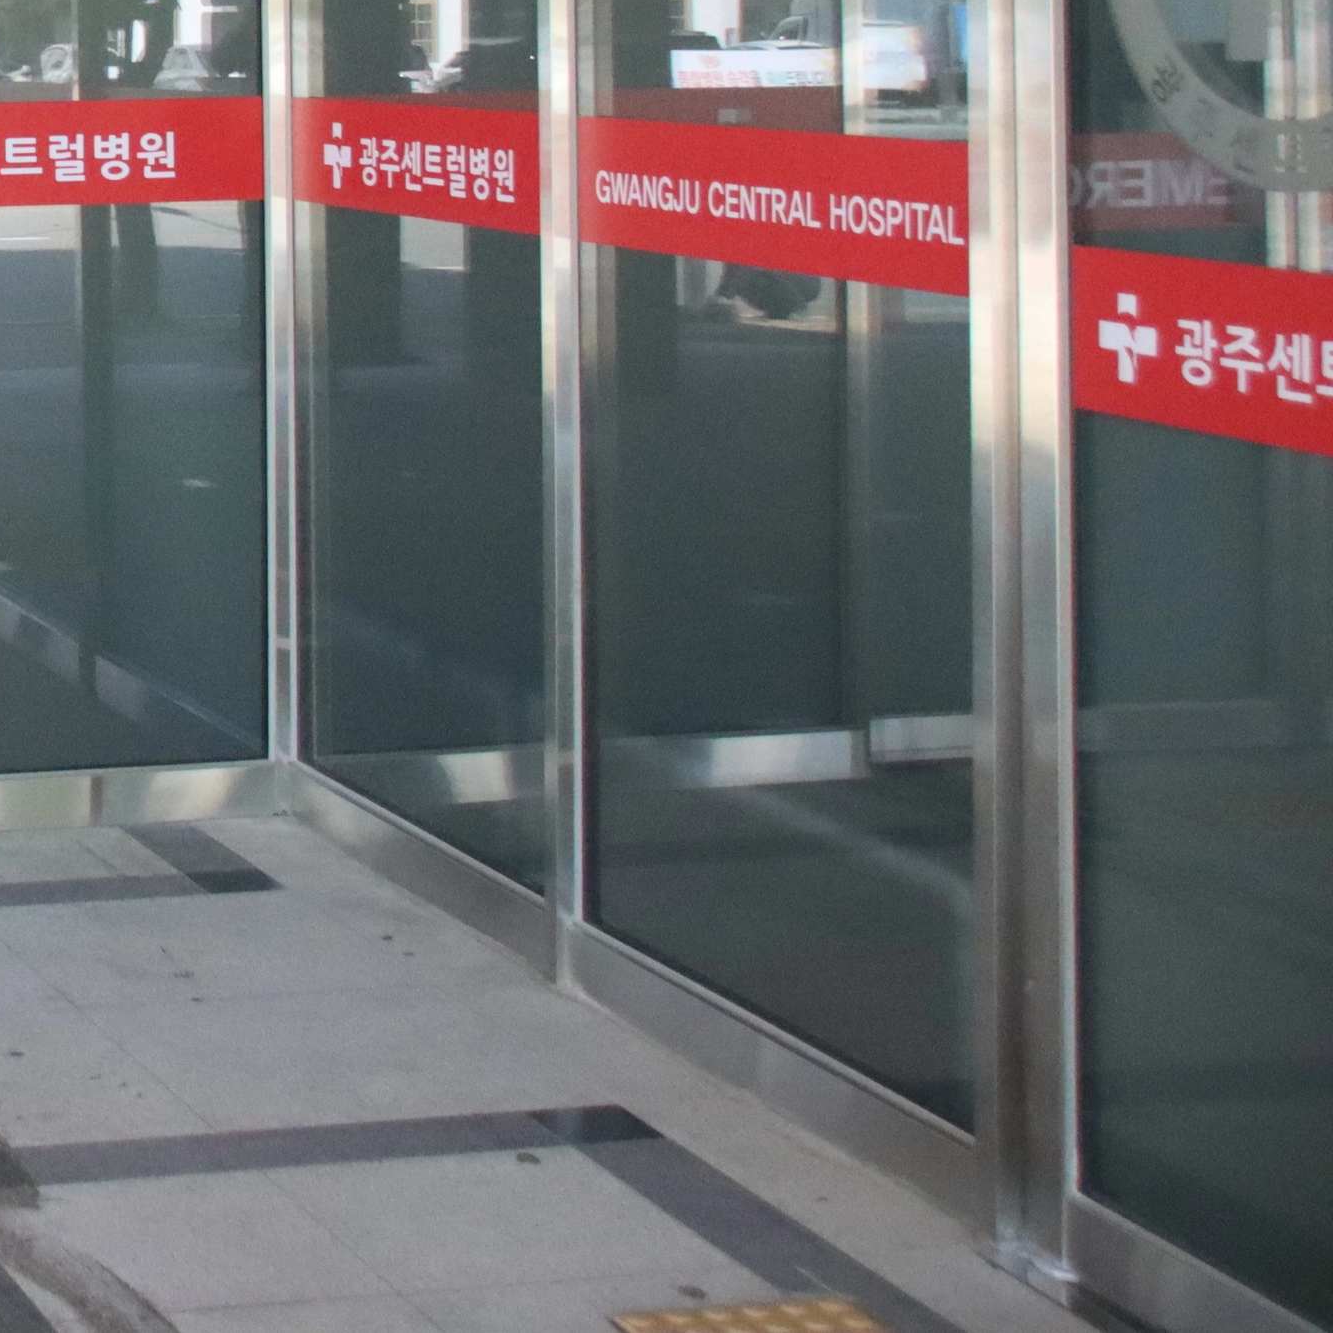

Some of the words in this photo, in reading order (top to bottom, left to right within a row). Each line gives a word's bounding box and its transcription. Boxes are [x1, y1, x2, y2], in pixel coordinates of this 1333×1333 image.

[359, 136, 516, 204] 광주센트럴병원
[595, 169, 701, 215] GWANGJU
[707, 181, 822, 229] CENTRAL
[829, 194, 966, 246] HOSPITAL
